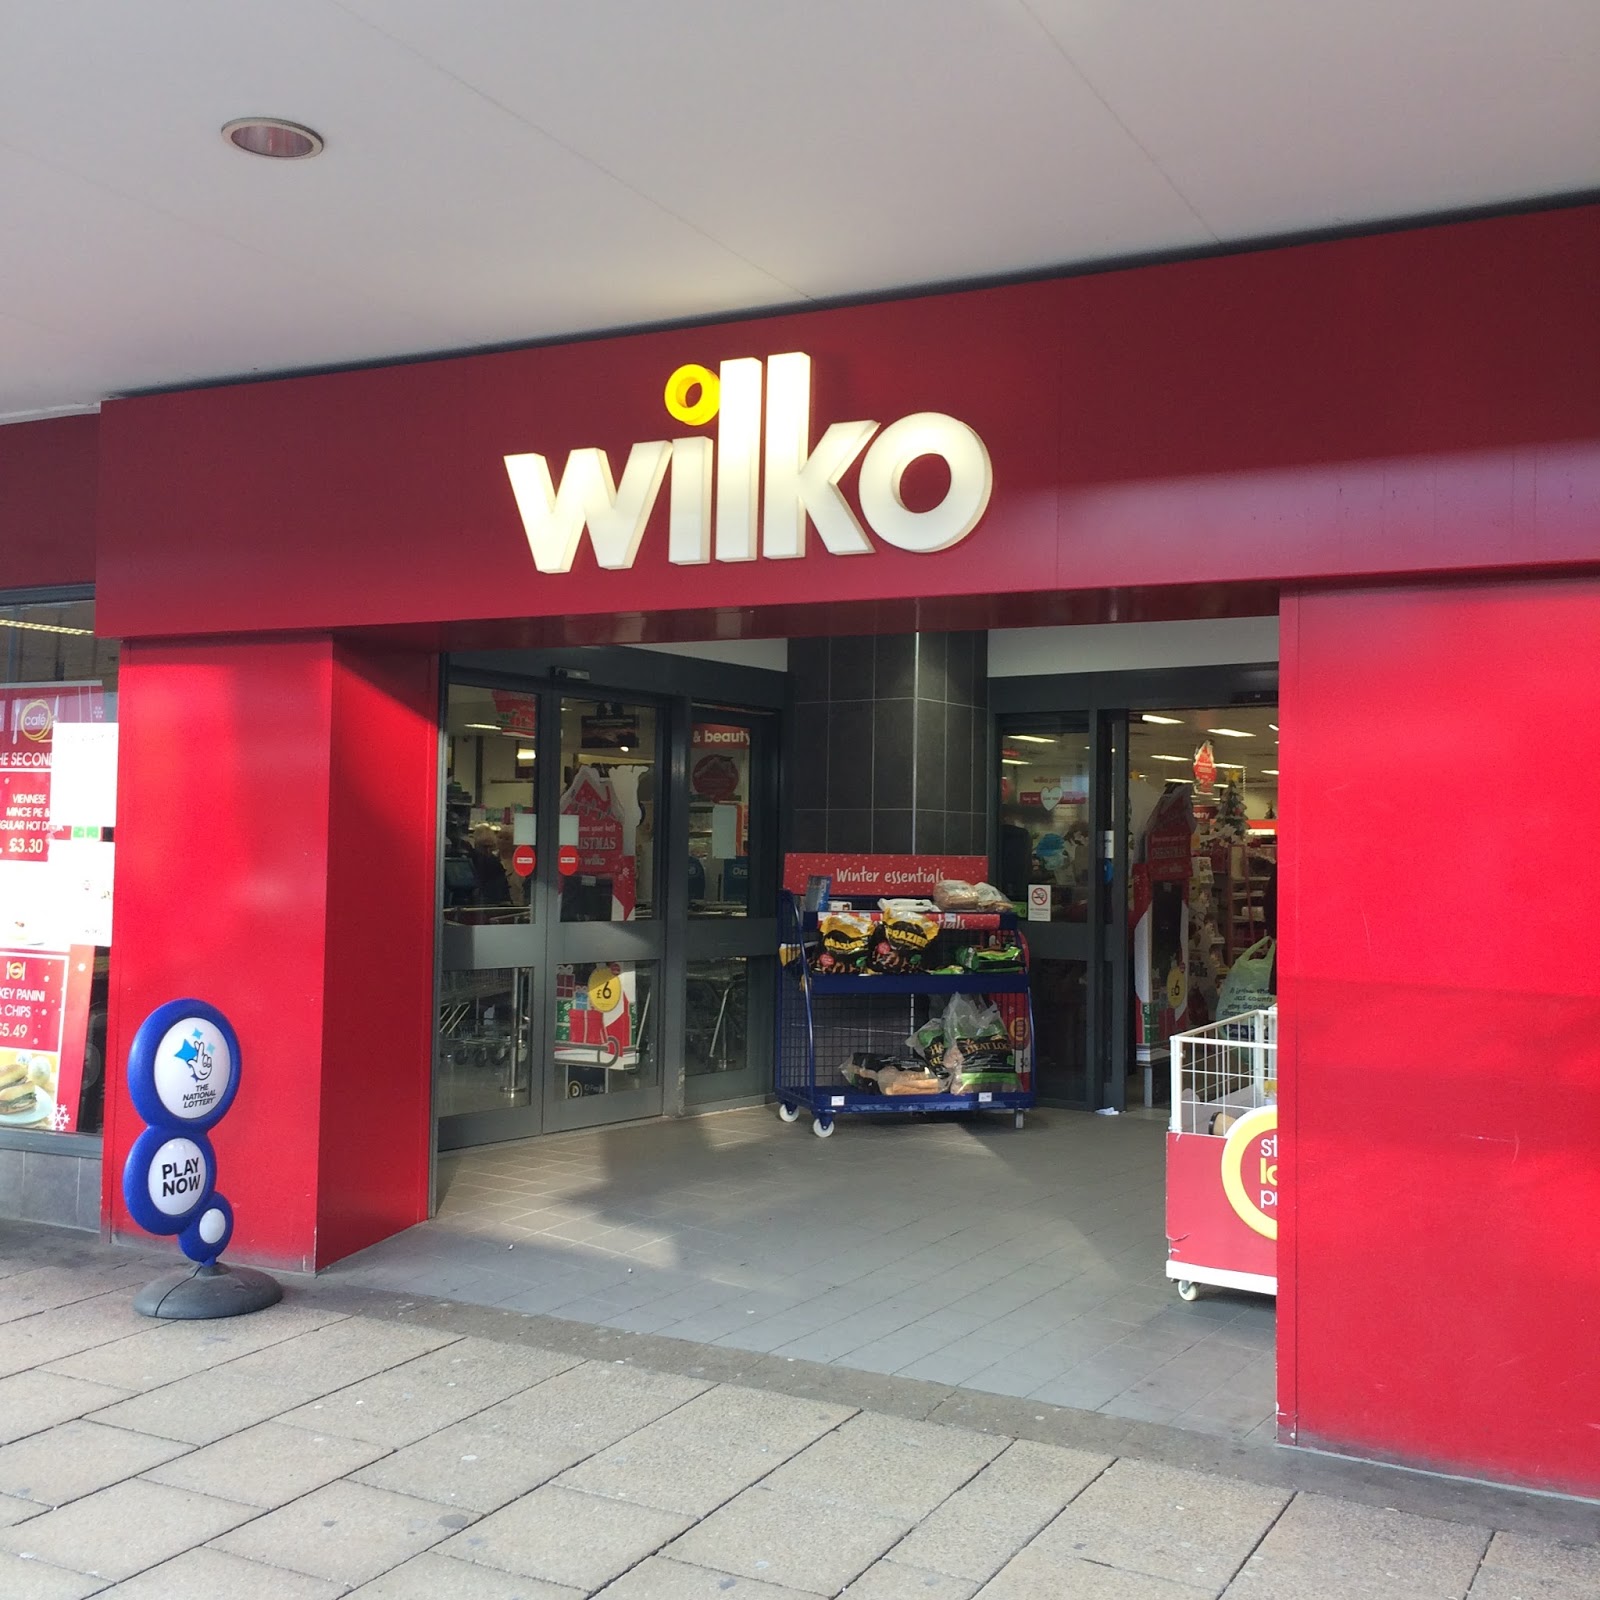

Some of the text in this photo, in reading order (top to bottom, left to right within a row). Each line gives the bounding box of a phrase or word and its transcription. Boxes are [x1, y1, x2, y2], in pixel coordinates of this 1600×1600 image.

[503, 352, 993, 574] wilko
[25, 713, 46, 726] café
[704, 730, 750, 746] beauty
[6, 806, 32, 817] MINCE
[0, 820, 25, 830] GULAR
[26, 821, 41, 831] HOT
[9, 837, 44, 853] £3.30
[580, 837, 616, 850] ISTMAS
[837, 866, 945, 883] Winter essentials
[16, 988, 46, 1002] PANINI
[596, 981, 612, 999] £6
[4, 1004, 31, 1019] CHIPS
[183, 1090, 216, 1101] NATIONAL
[184, 1098, 215, 1108] LOTTERY
[162, 1158, 199, 1179] PLAY
[163, 1175, 200, 1197] NOW
